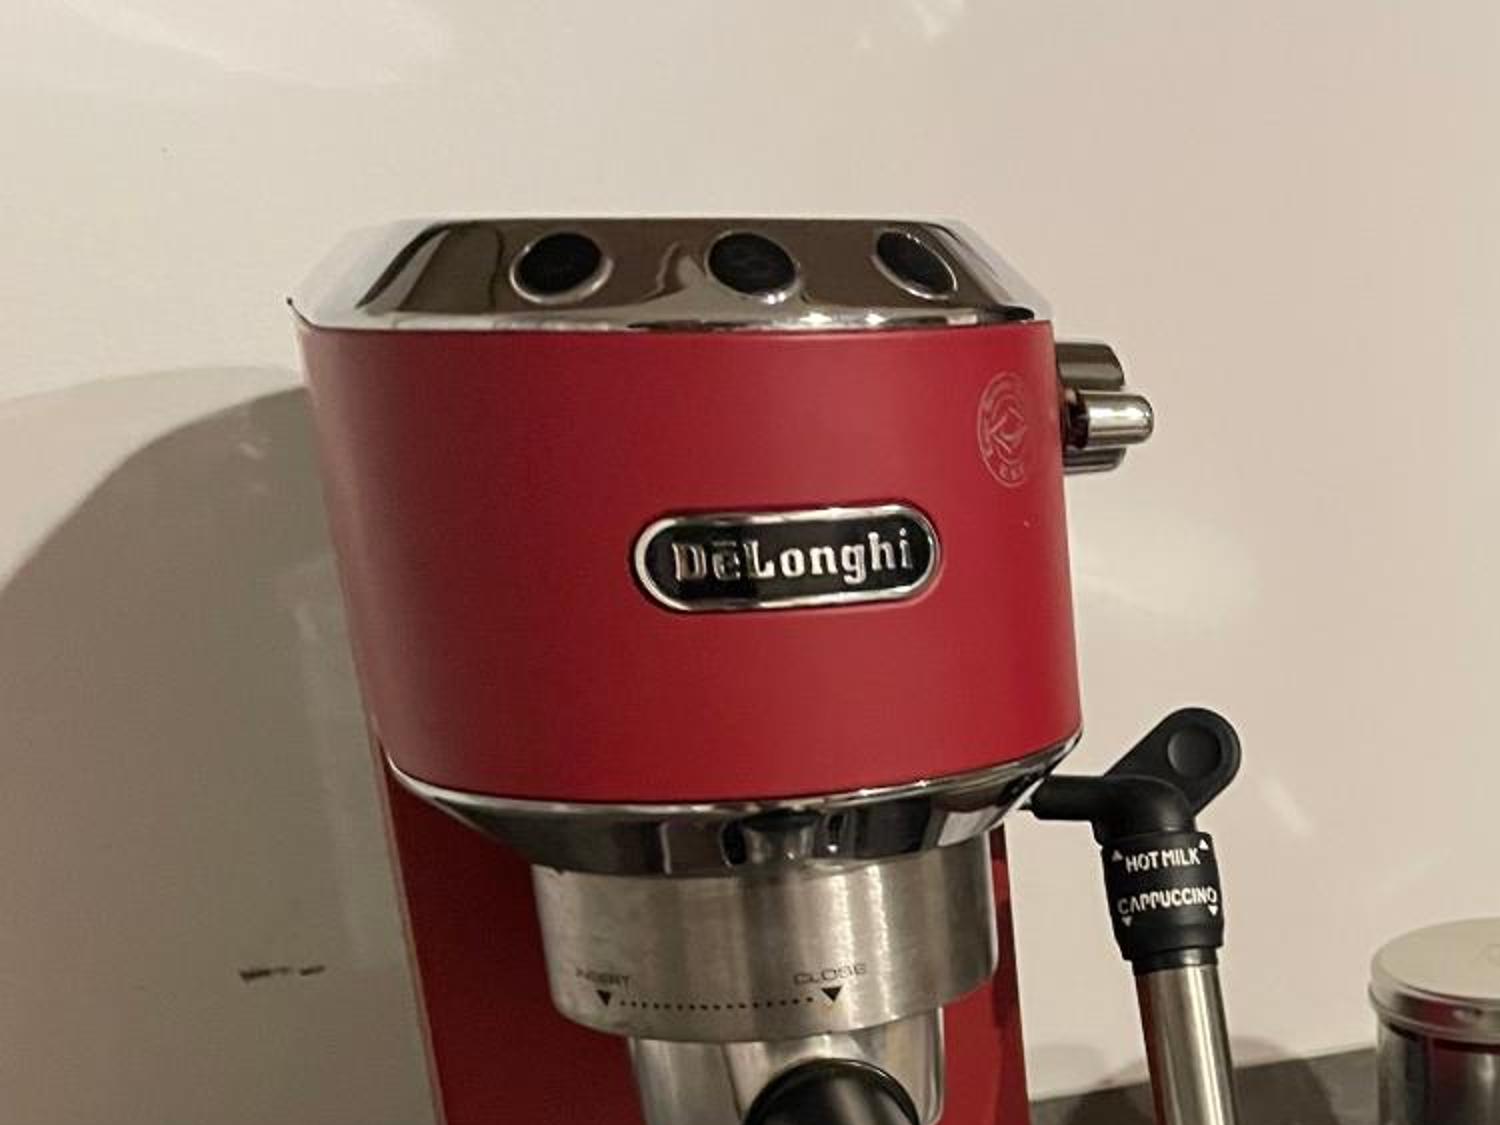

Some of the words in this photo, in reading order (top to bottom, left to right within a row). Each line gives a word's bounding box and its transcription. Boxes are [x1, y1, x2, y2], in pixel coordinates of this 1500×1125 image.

[1126, 851, 1158, 872] HOT
[1162, 848, 1200, 867] MILK
[1117, 886, 1217, 914] CAPPUCCINO
